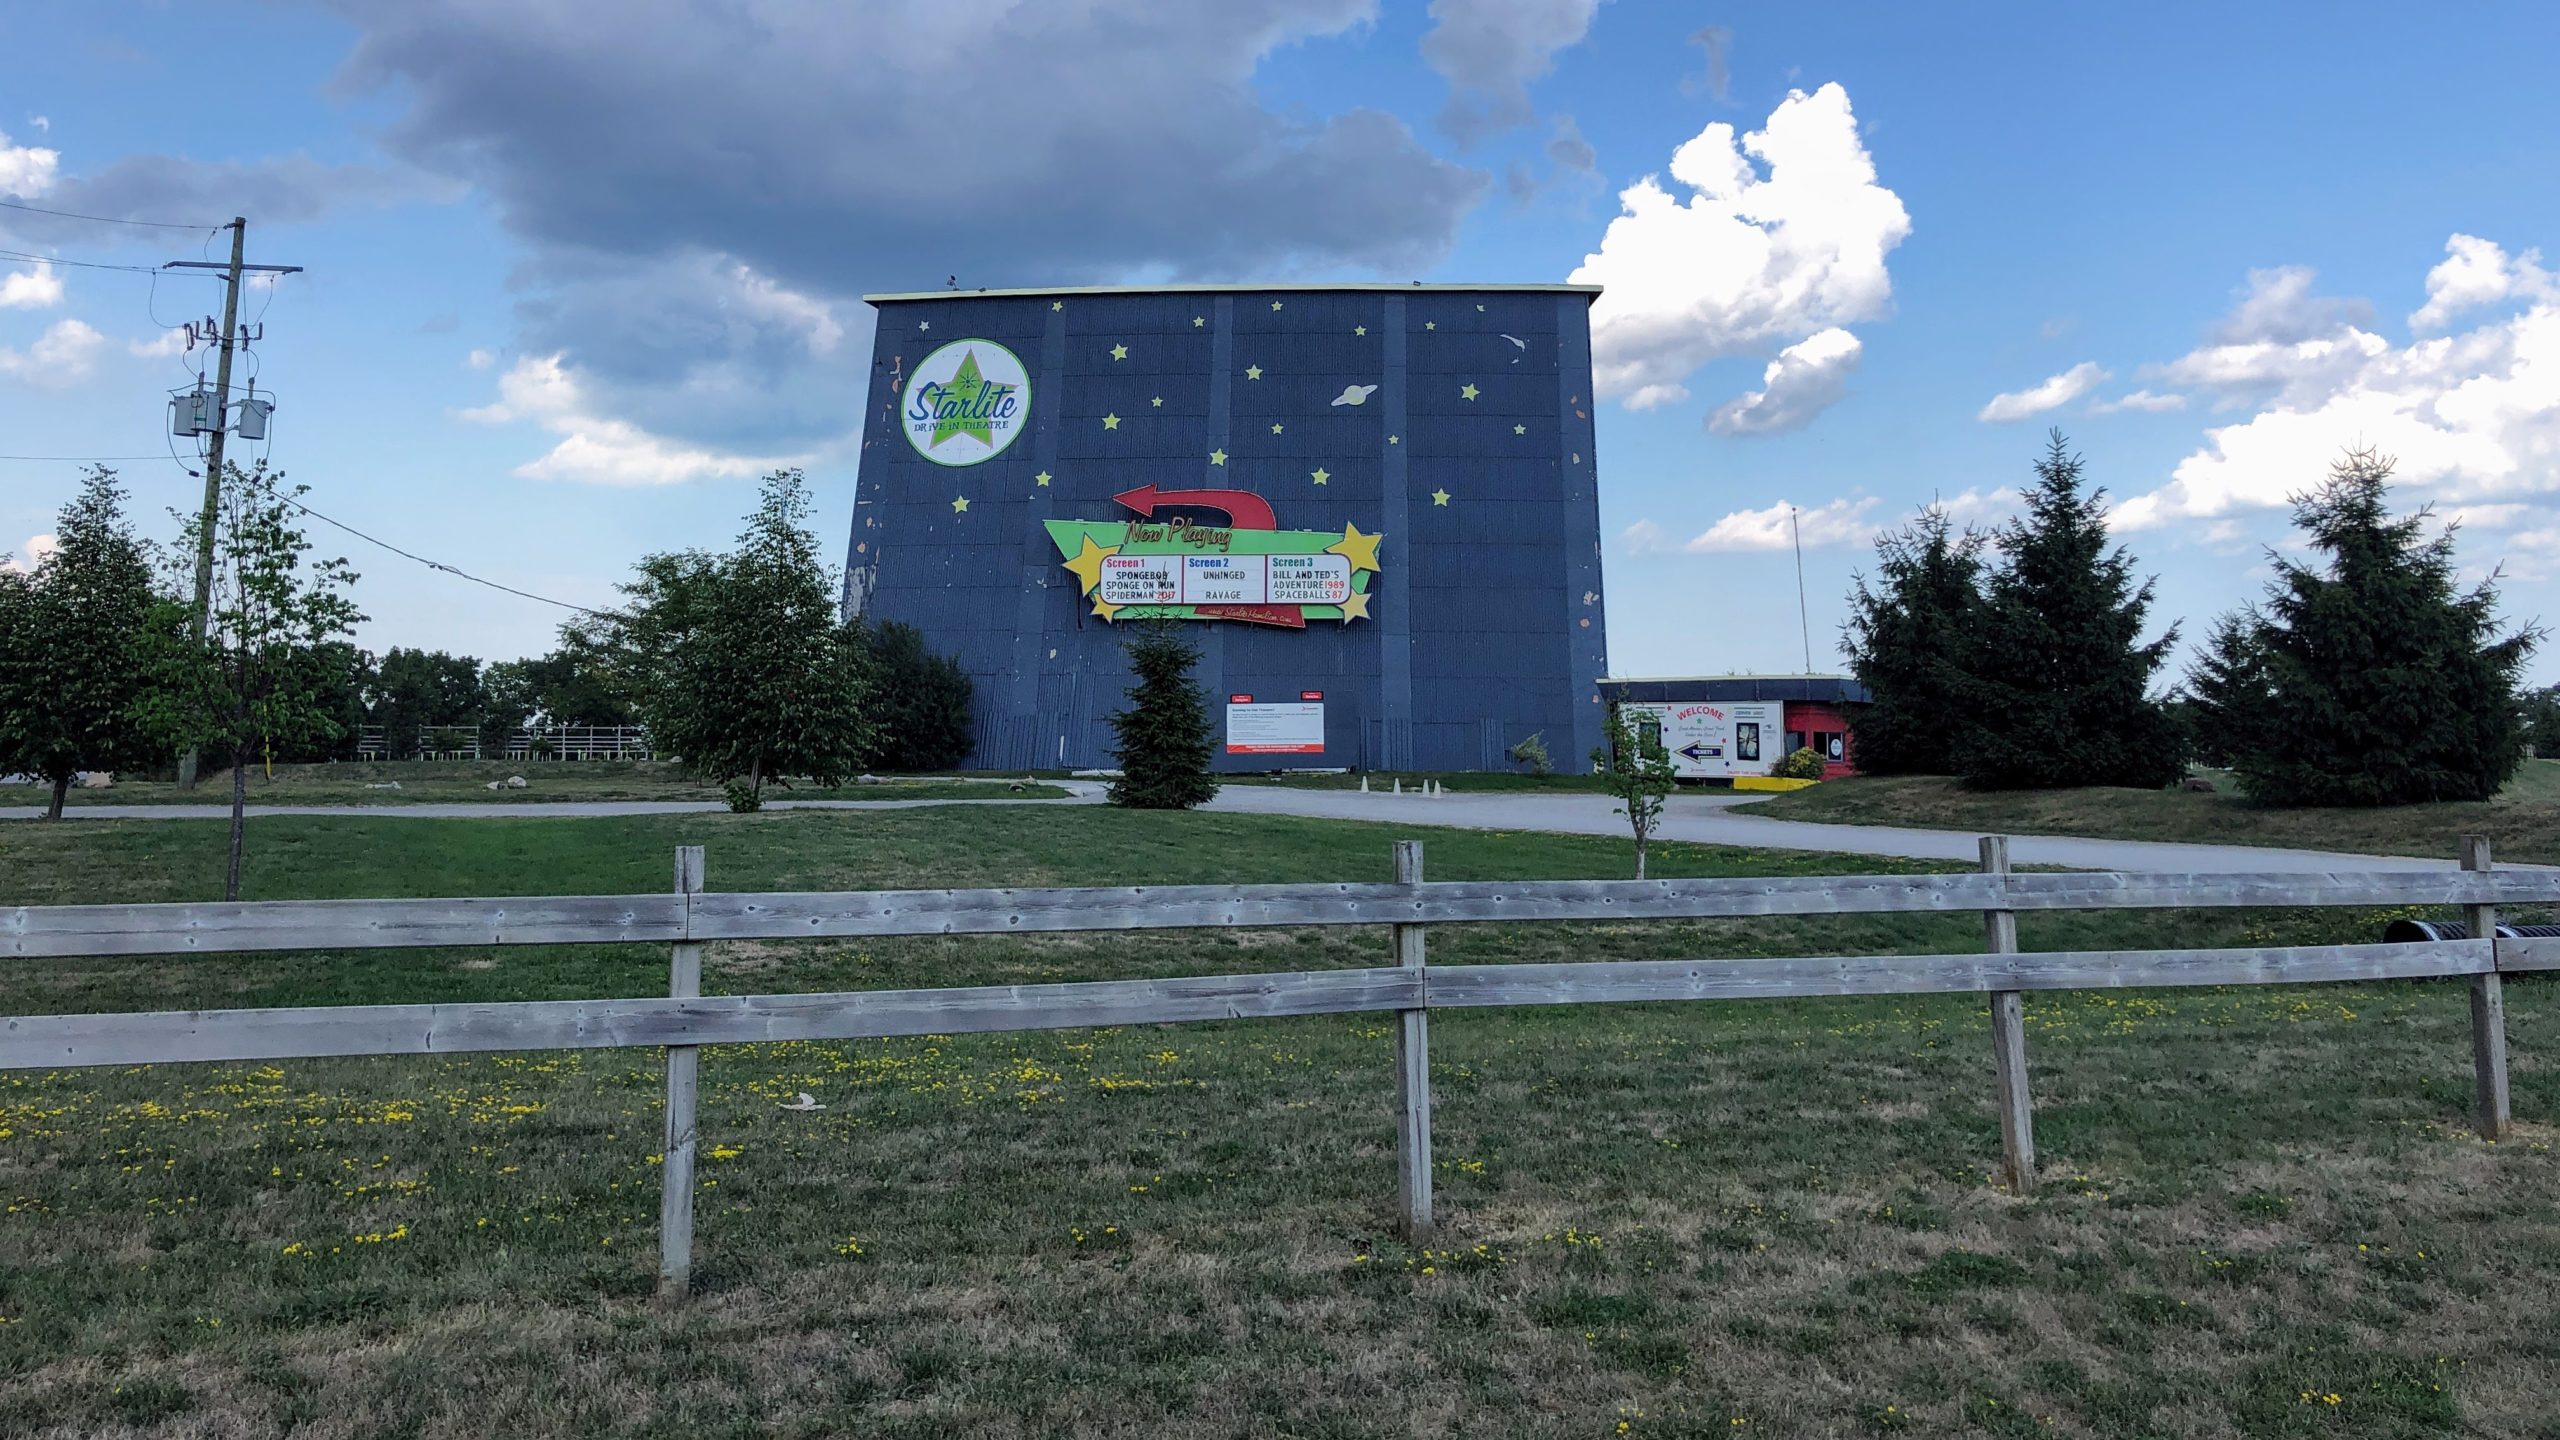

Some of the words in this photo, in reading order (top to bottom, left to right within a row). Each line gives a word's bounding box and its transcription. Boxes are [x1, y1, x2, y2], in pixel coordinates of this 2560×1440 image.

[908, 380, 1018, 420] Starlite
[963, 420, 1009, 431] THEATRE
[1123, 518, 1163, 544] Now
[1167, 516, 1233, 552] Playing
[1106, 558, 1139, 568] Screen
[1140, 558, 1145, 568] 1
[1189, 558, 1221, 568] Screen
[1223, 558, 1229, 568] 2
[1272, 557, 1305, 567] Screen
[1307, 557, 1313, 567] 3
[1116, 571, 1168, 580] SPONGEBOB
[1203, 571, 1246, 580] UNHINGED
[1272, 570, 1292, 579] BILL
[1295, 570, 1313, 579] AND
[1315, 570, 1340, 579] TED'S
[1106, 581, 1140, 590] SPONGE
[1142, 581, 1154, 590] ON
[1157, 581, 1175, 590] RUN
[1106, 591, 1154, 600] SPIDERMAN
[1205, 591, 1242, 600] RAVAGE
[1274, 591, 1331, 599] SPACEBALLS
[1332, 591, 1343, 599] 87
[1676, 706, 1725, 720] WELCOME
